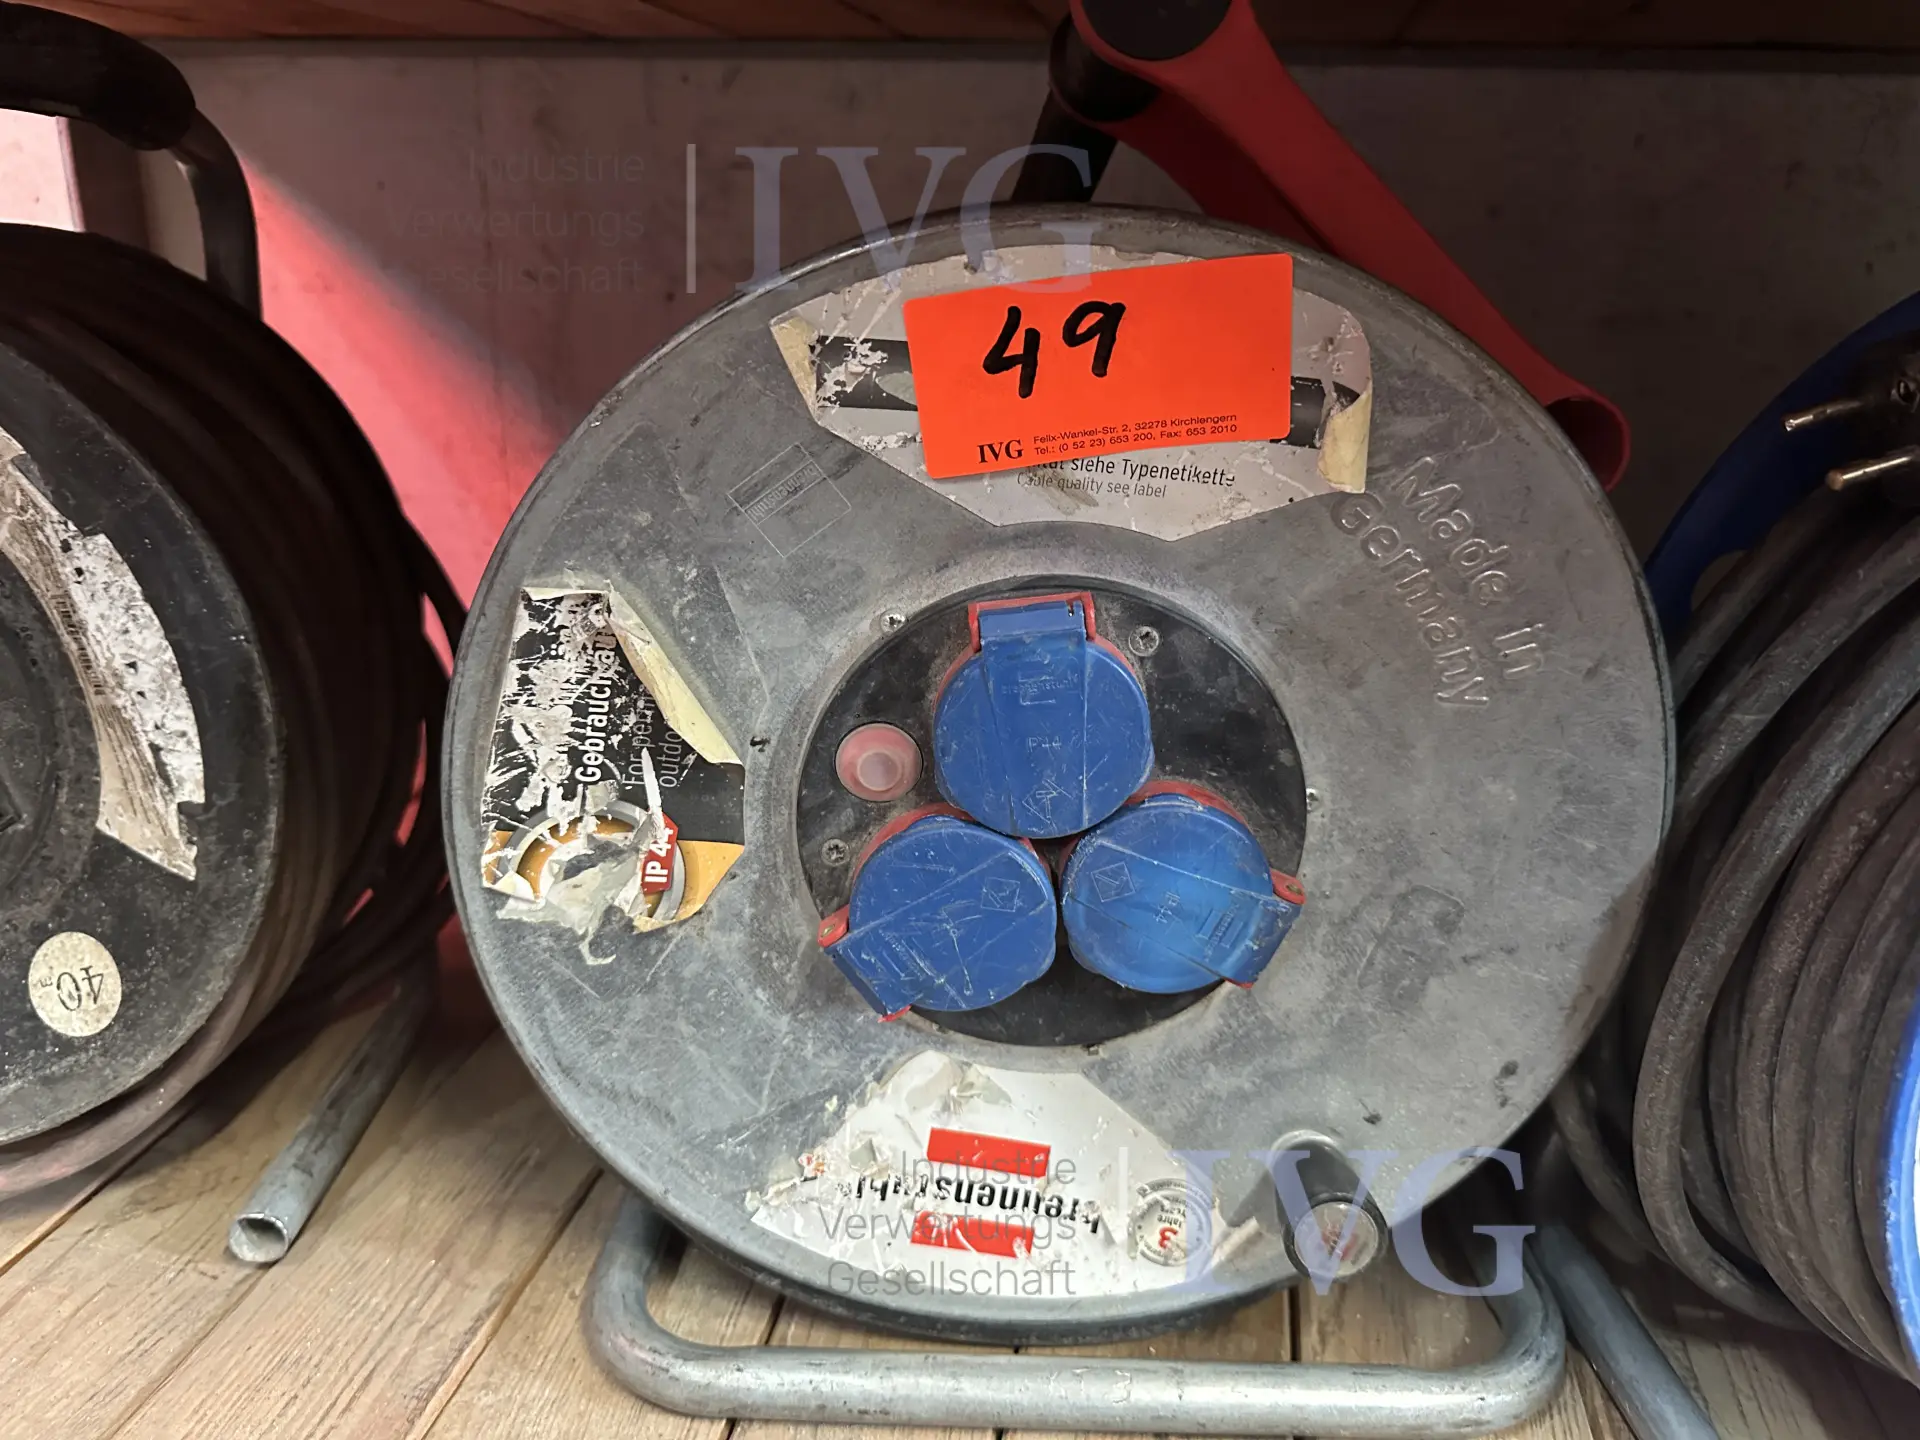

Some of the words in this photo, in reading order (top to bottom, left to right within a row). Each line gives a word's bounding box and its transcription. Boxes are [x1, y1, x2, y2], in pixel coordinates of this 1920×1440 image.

[982, 300, 1126, 399] 49
[1033, 426, 1119, 444] Felix-Wankel-Str.
[1121, 424, 1132, 433] 2,
[1134, 420, 1168, 431] 32278
[1170, 414, 1237, 427] Kirchlengern
[1034, 445, 1055, 455] Tel.:
[1058, 442, 1069, 454] (0
[1072, 441, 1086, 450] 52
[1089, 438, 1106, 448] 23)
[1109, 434, 1130, 445] 653
[1133, 432, 1156, 442] 200,
[1160, 429, 1182, 440] Fax:
[1186, 427, 1207, 437] 653
[1210, 424, 1238, 434] 2010
[977, 439, 1024, 464] IVG
[1057, 477, 1103, 494] quality
[1106, 481, 1130, 494] see
[1133, 482, 1167, 498] label
[1122, 459, 1236, 487] Typenetikette
[1493, 622, 1546, 680] in
[644, 861, 668, 882] IP
[57, 965, 104, 1012] 40
[1158, 1226, 1178, 1249] 3
